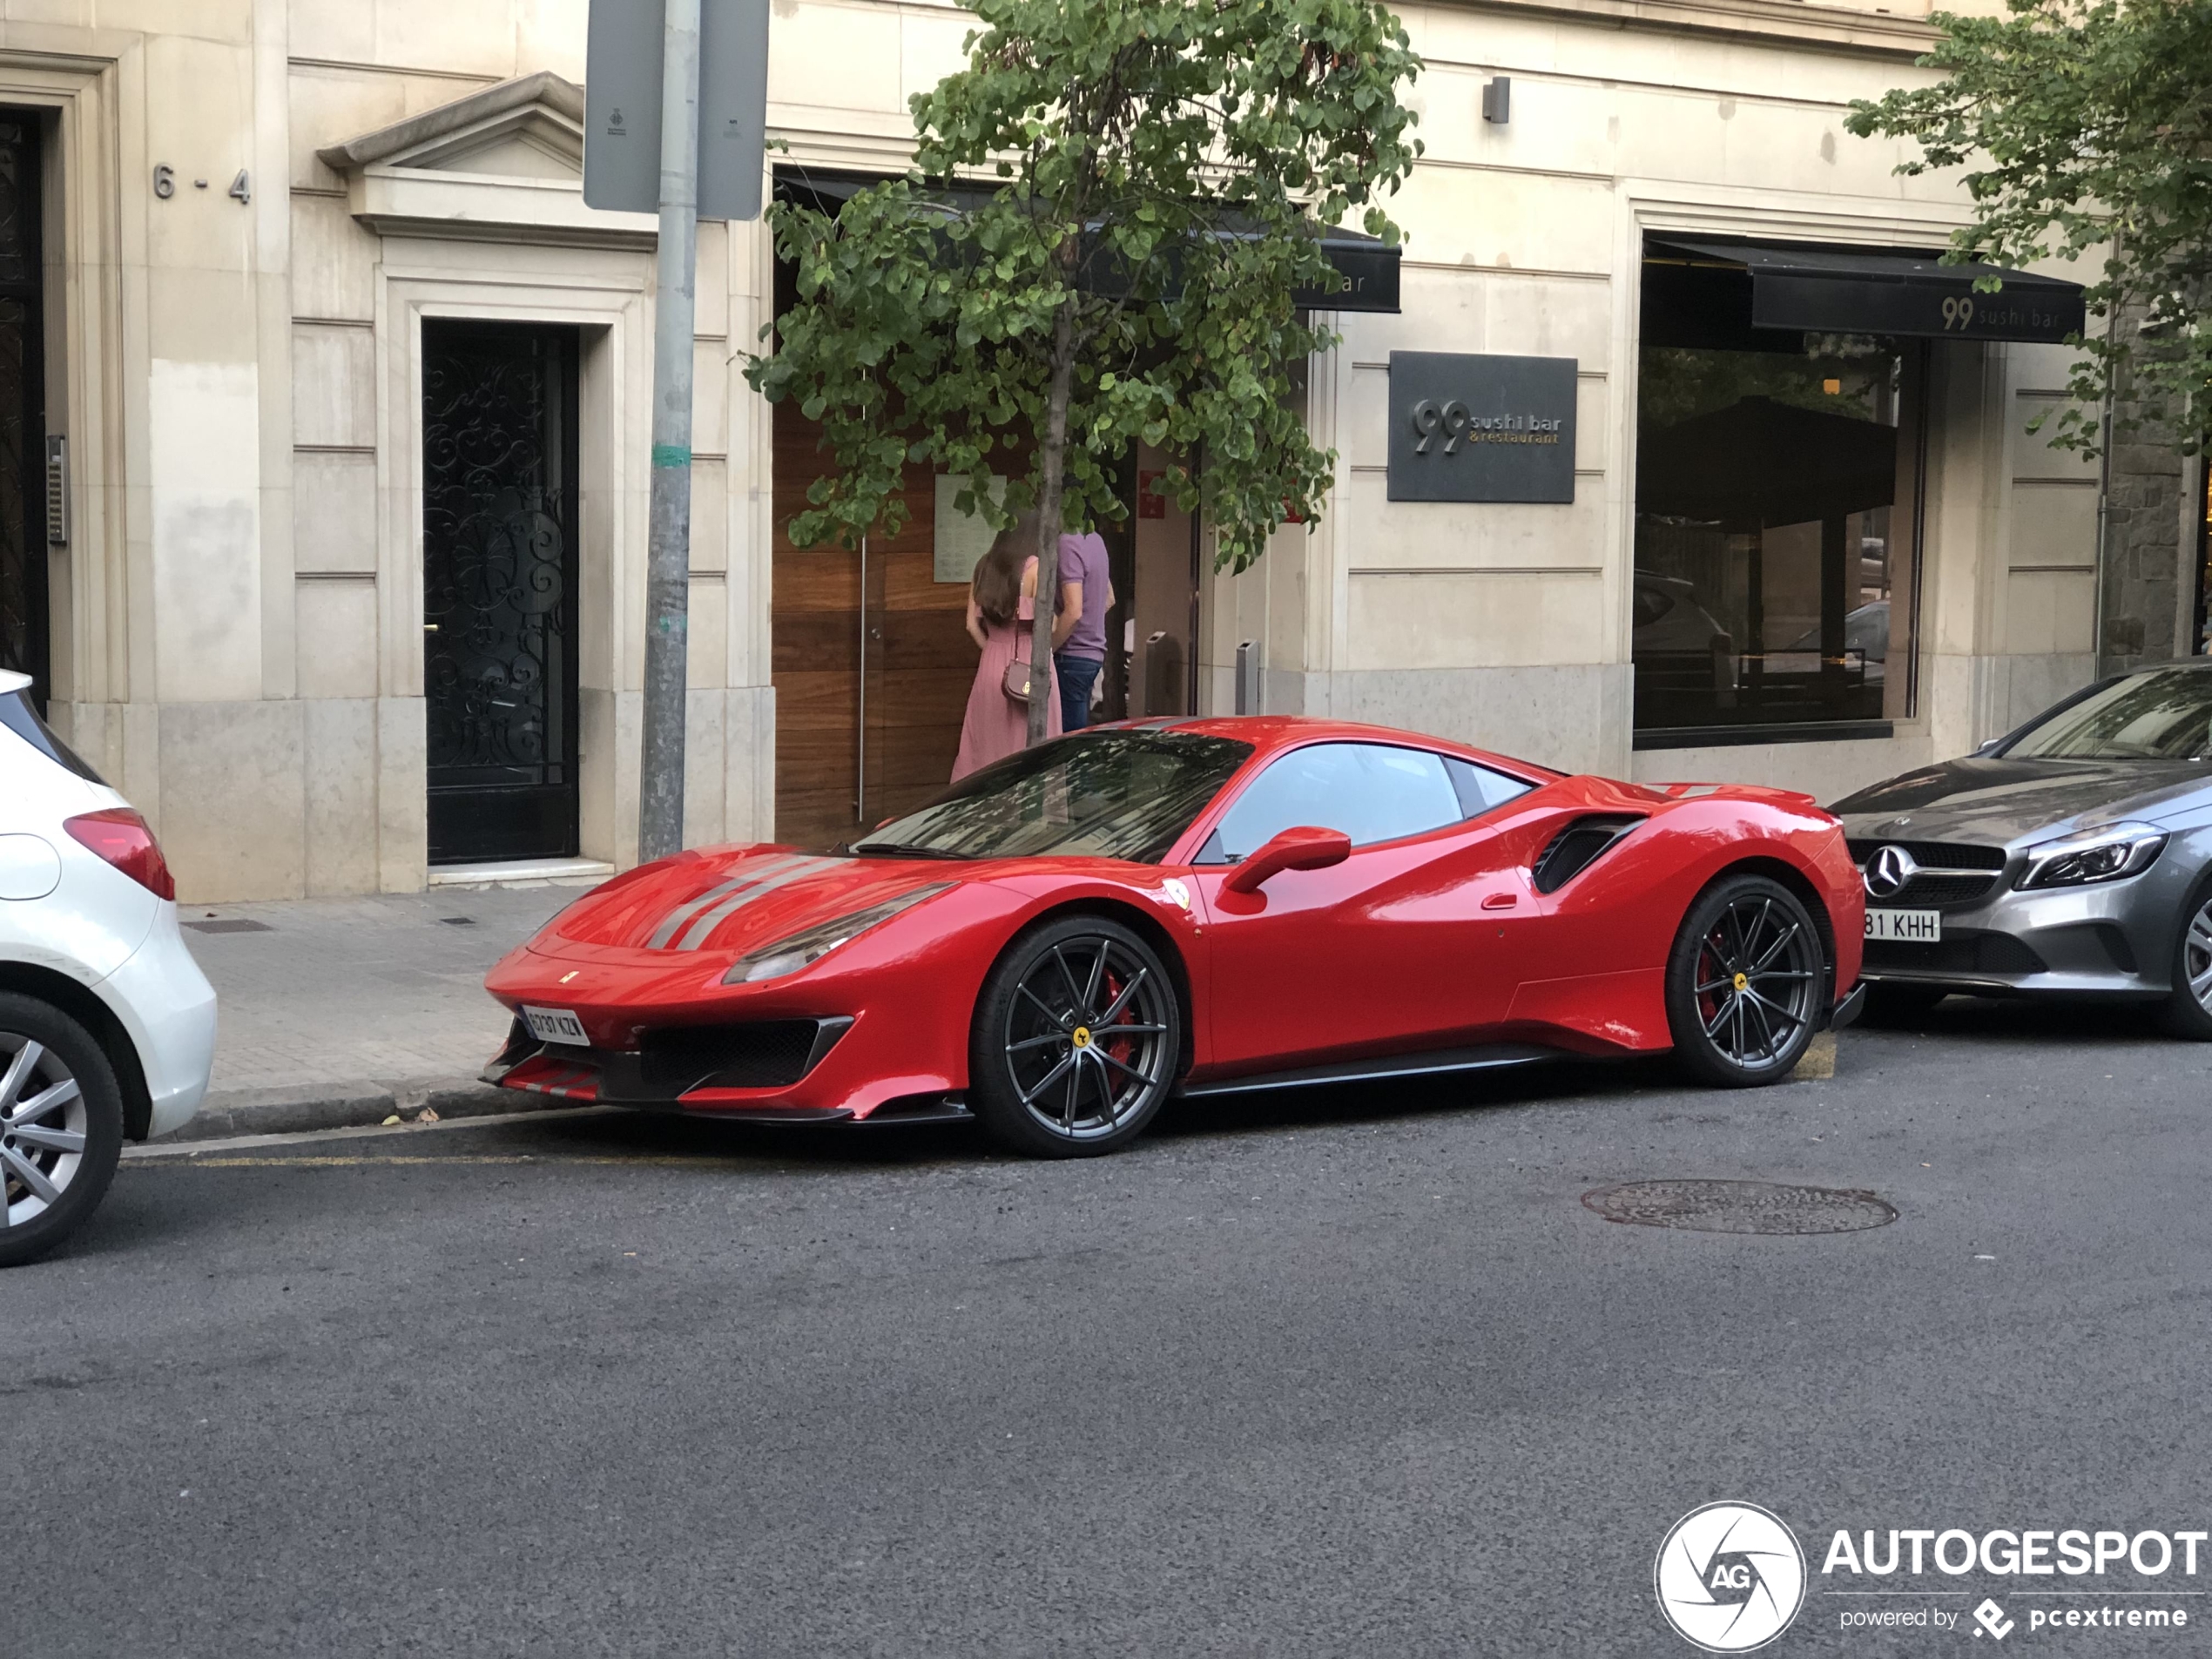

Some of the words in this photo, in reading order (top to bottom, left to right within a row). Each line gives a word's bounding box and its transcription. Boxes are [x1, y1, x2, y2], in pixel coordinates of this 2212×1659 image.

[153, 163, 174, 199] 6
[228, 168, 250, 205] 4
[1941, 296, 1974, 331] 99
[1979, 307, 2026, 326] sushi
[2032, 308, 2060, 328] bar
[1413, 399, 1471, 454] 99
[1470, 413, 1523, 431] sushi
[1528, 415, 1562, 431] bar
[1893, 914, 1934, 938] KHH
